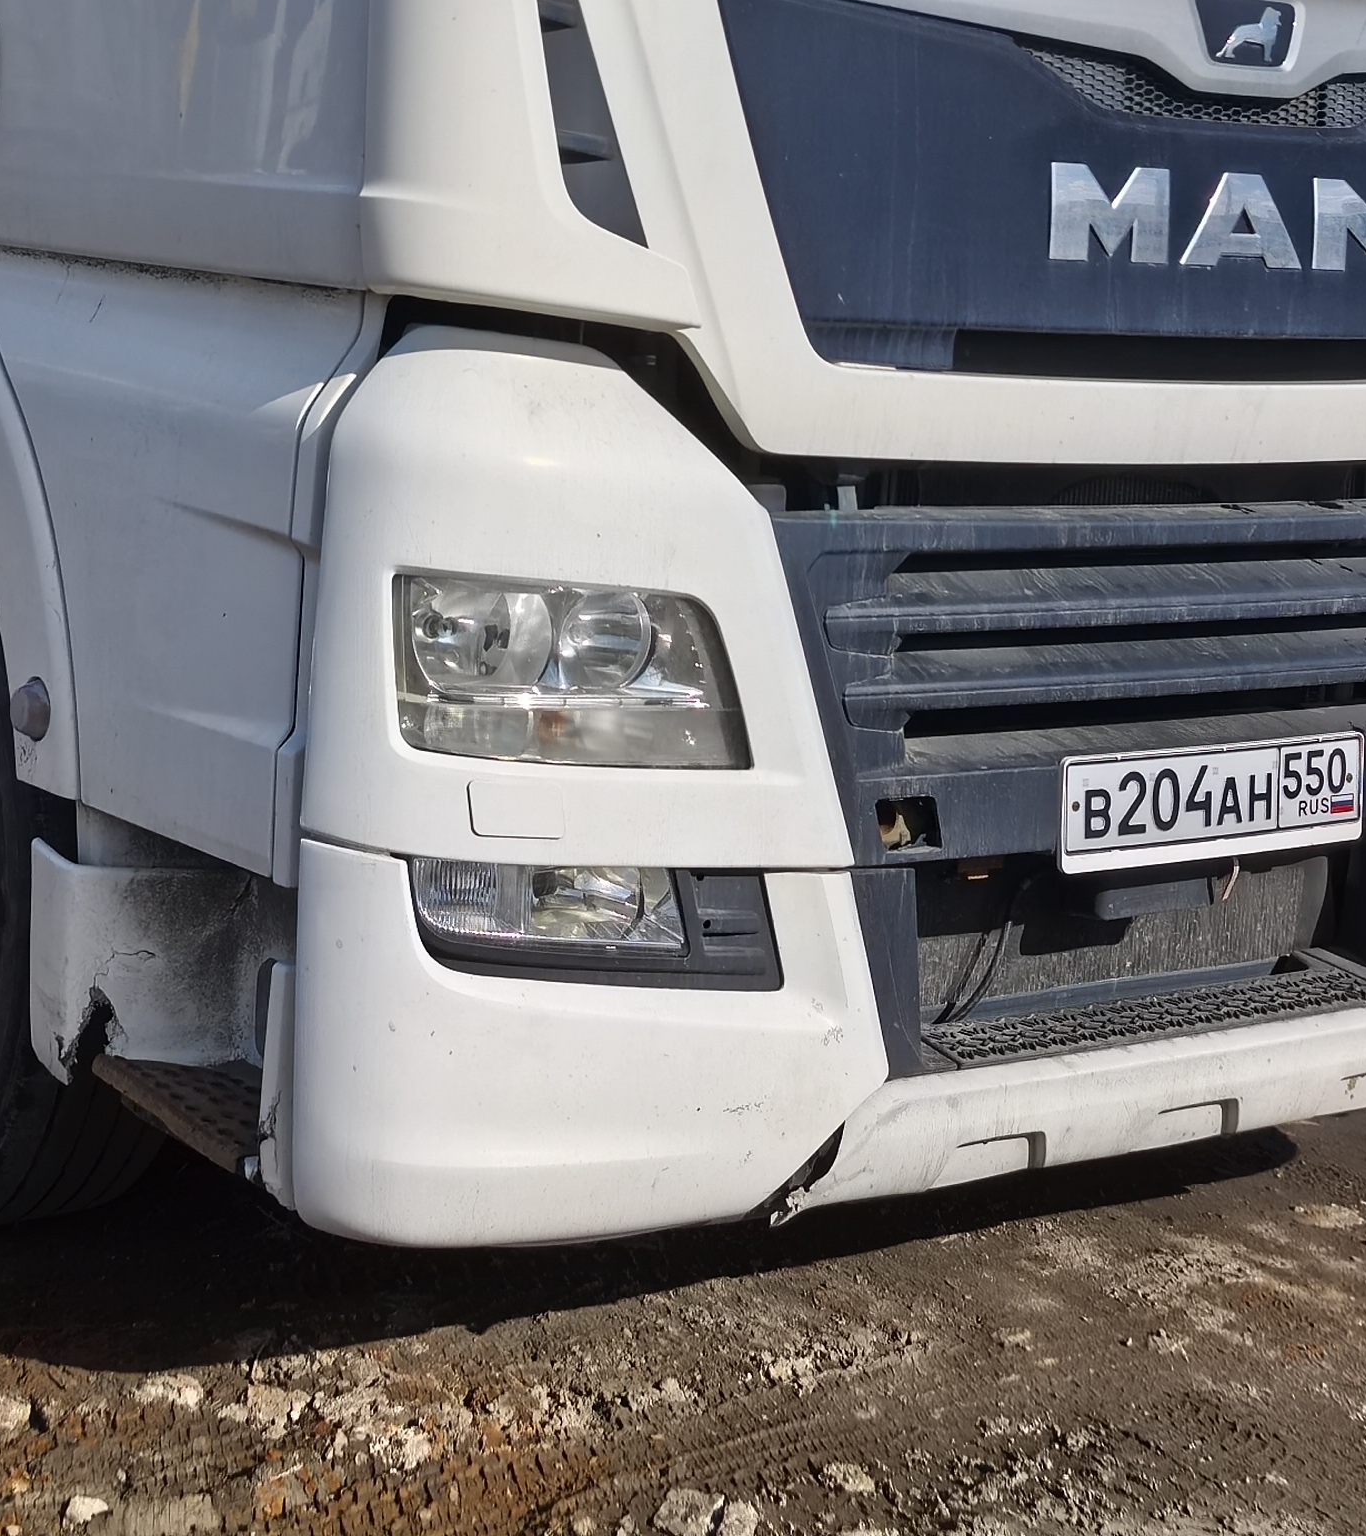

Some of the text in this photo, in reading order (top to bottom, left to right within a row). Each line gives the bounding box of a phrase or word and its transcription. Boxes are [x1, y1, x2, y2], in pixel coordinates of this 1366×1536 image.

[1084, 747, 1347, 840] В204АН 550
[1298, 796, 1330, 817] RUS
